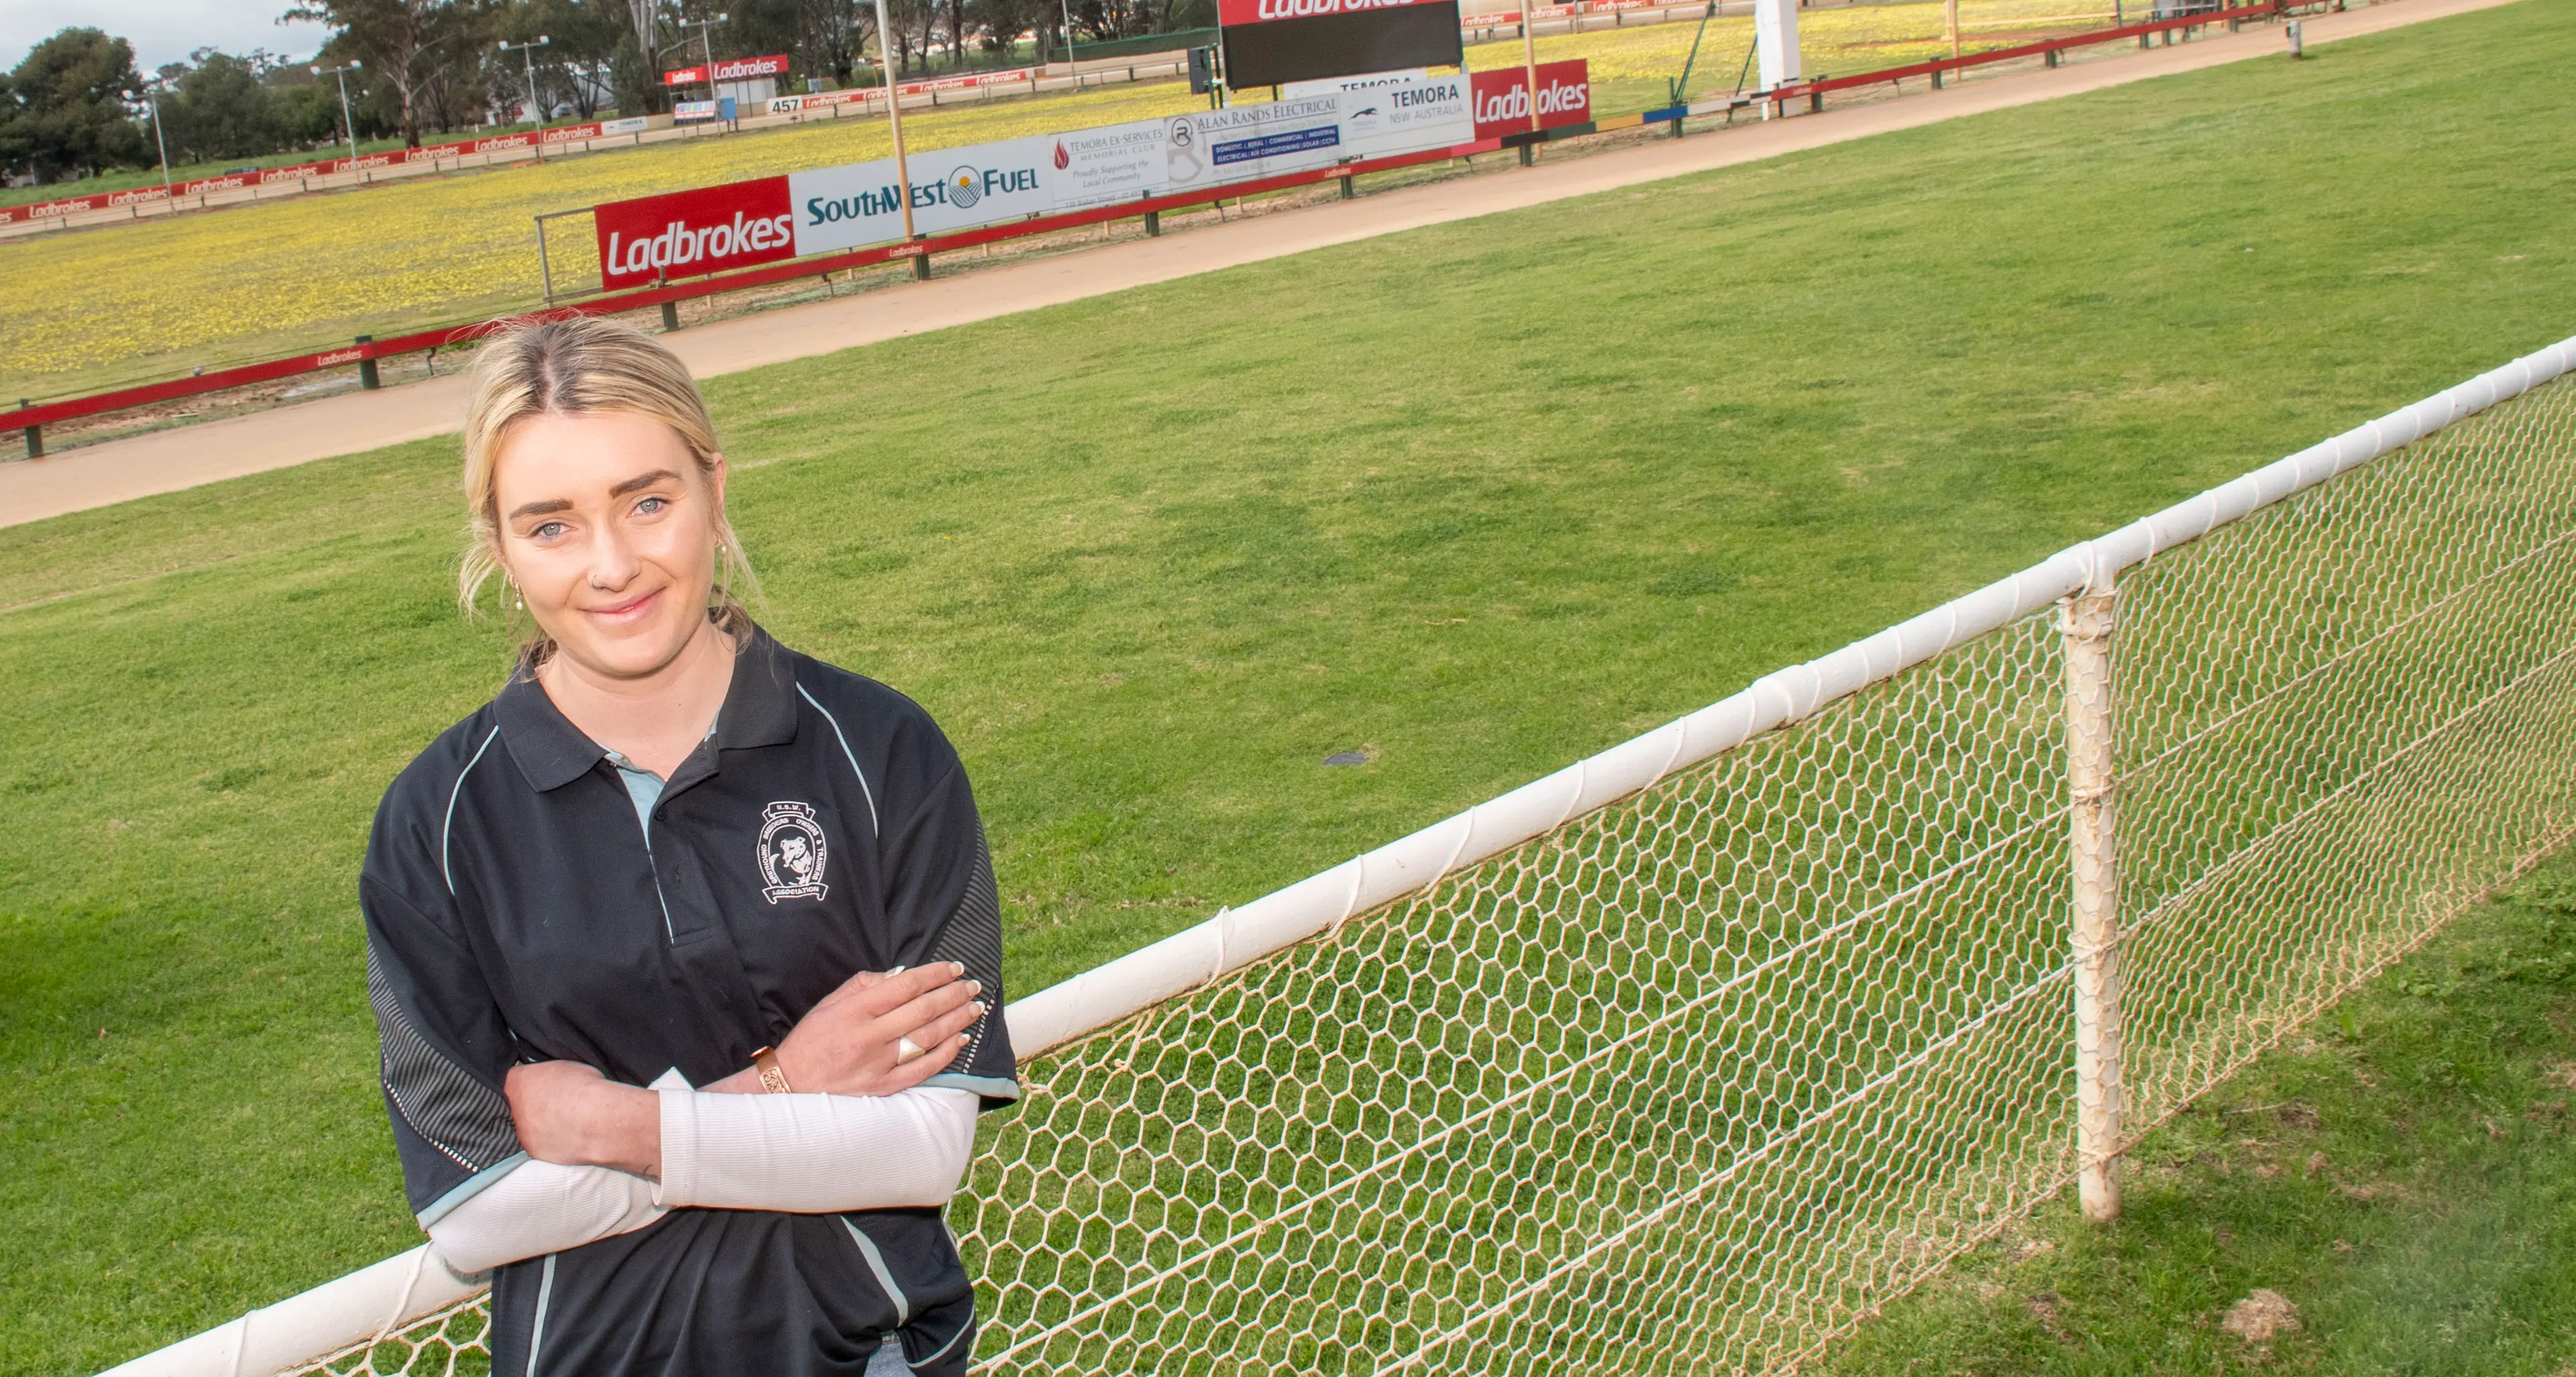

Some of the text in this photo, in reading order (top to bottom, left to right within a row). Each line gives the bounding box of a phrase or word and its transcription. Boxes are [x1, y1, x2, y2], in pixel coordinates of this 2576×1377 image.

[714, 59, 777, 79] Ladbrokes
[773, 99, 798, 113] 457
[1391, 84, 1460, 109] TEMORA
[1197, 99, 1337, 131] ALAN RANDS ELECTRICAL
[1390, 103, 1464, 125] NSW AUSTRALIA
[543, 125, 594, 143] Ladbrokes
[1069, 129, 1163, 152] TEMORA EX-SERVICES
[1269, 133, 1303, 145] COMMERCIAL
[405, 145, 460, 162] Ladbrokes
[474, 135, 528, 153] Ladbrokes
[1079, 144, 1156, 162] MEMORIAL CLUB
[1217, 151, 1248, 162] ELECTRICAL
[1261, 142, 1300, 155] CONDITIONING
[1303, 139, 1320, 148] SOLAR
[1322, 136, 1336, 145] CCTV
[260, 165, 317, 184] Ladbrokes
[1073, 158, 1149, 179] Proudly Supporting the
[185, 176, 244, 195] Ladbrokes
[983, 168, 1039, 197] FUEL
[1083, 172, 1141, 188] Local Community
[108, 188, 168, 207] Ladbrokes
[30, 199, 91, 219] Ladbrokes
[608, 211, 792, 276] Ladbrokes
[889, 245, 923, 258] Ladbrokes
[317, 349, 363, 366] Ladbrokes
[796, 818, 819, 837] OWNERS
[811, 846, 824, 881] TRAINERS
[771, 886, 820, 896] ASSOCIATION
